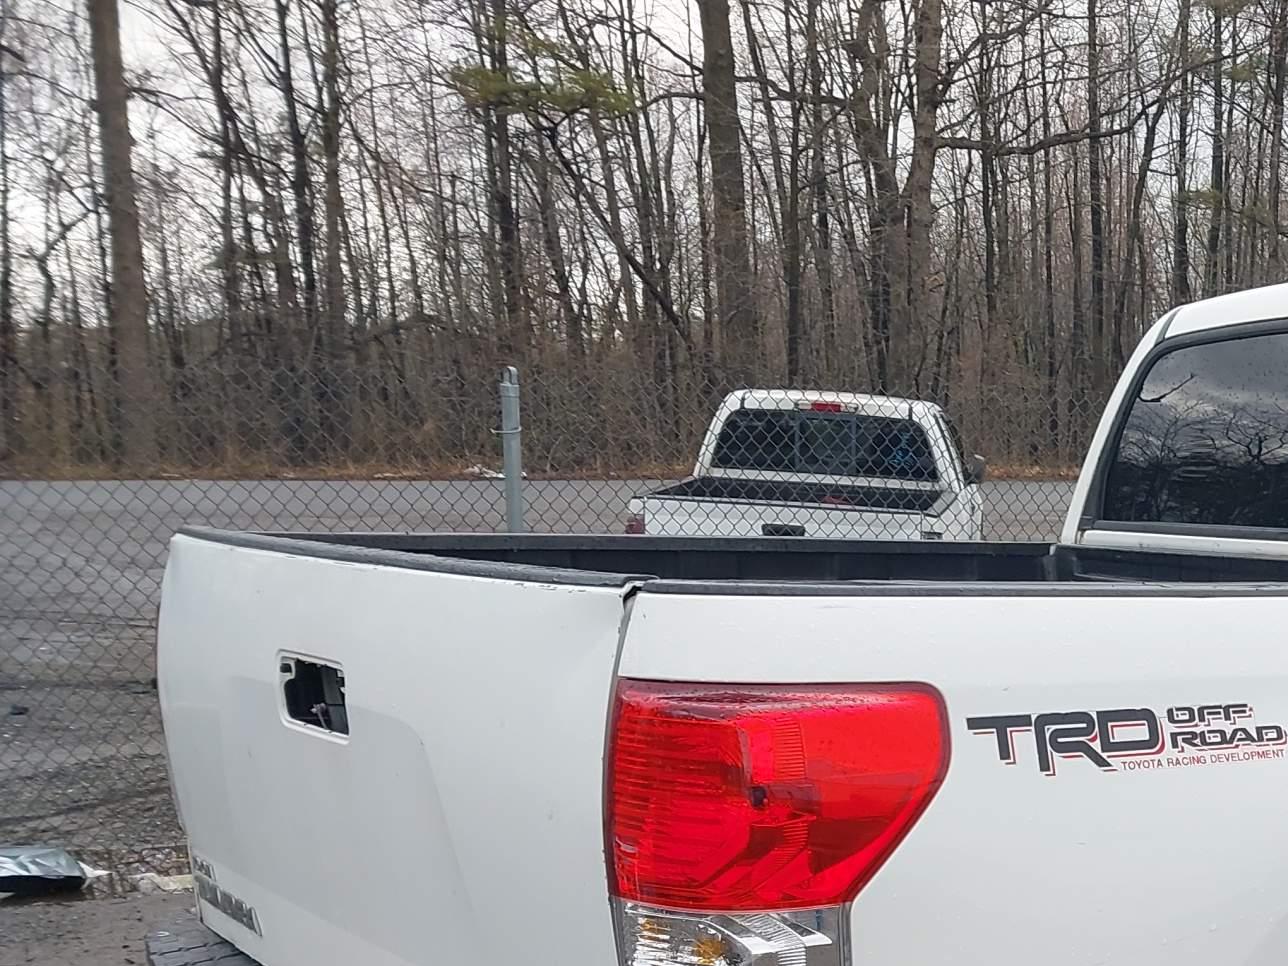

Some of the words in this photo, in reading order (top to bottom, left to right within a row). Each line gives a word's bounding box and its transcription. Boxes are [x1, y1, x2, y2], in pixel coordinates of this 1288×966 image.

[1167, 703, 1253, 728] OFF
[966, 708, 1164, 776] TRD
[1169, 725, 1288, 753] ROAD
[1121, 759, 1163, 771] TOYOTA
[1167, 754, 1207, 768] RACING
[1209, 748, 1285, 764] DEVELOPMENT
